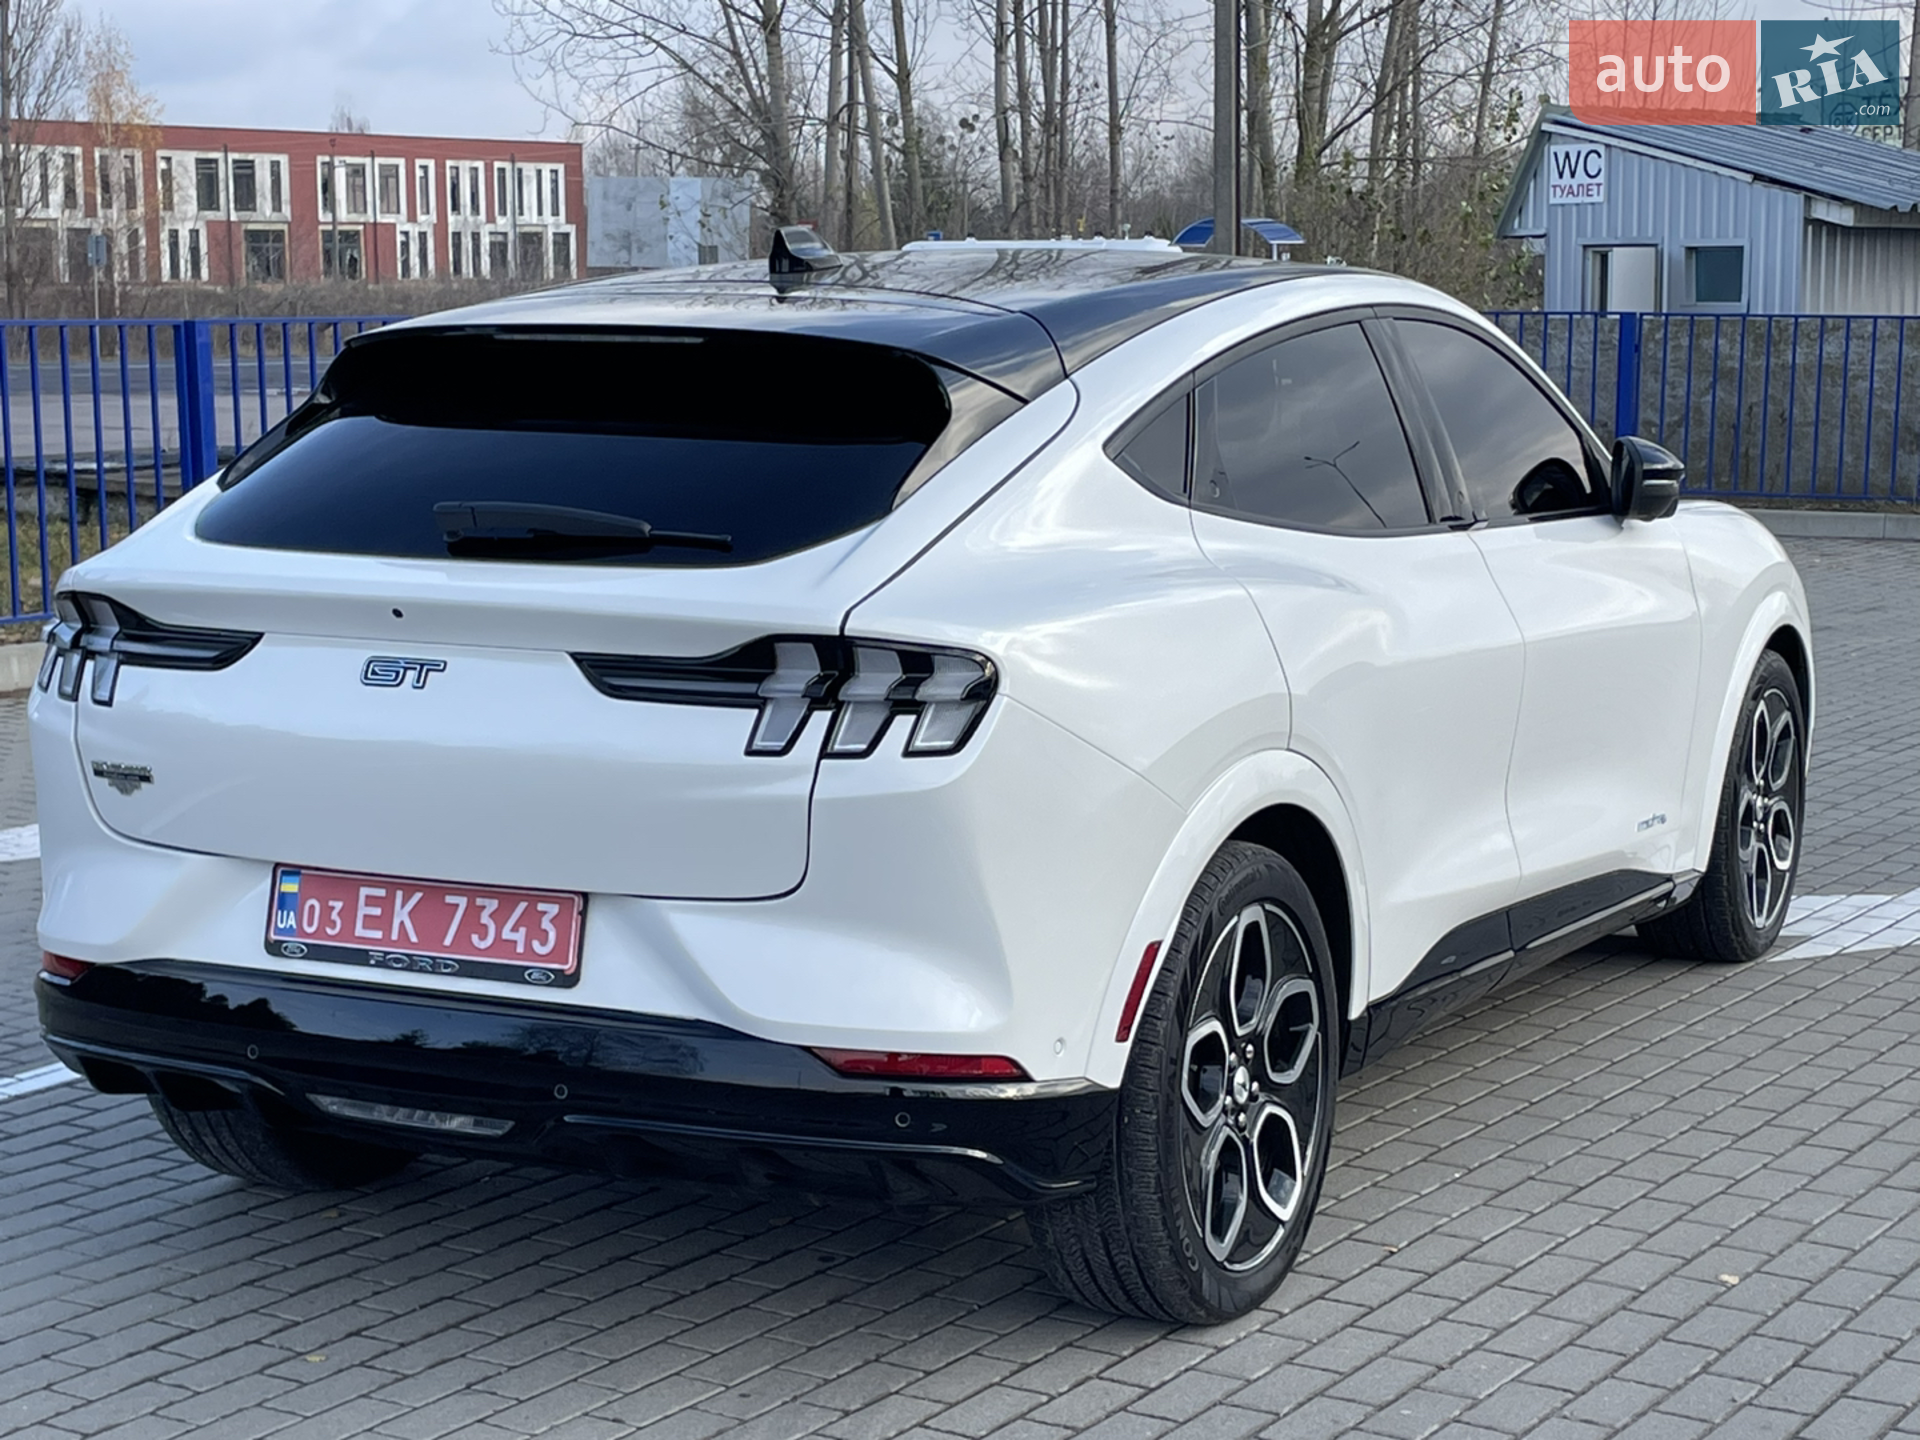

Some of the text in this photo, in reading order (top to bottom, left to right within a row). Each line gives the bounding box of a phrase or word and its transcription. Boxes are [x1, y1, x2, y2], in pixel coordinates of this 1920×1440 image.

[1553, 149, 1602, 180] WC
[1551, 183, 1603, 198] ТУАЛЕТ
[360, 655, 447, 690] GT
[276, 910, 297, 930] UA
[301, 886, 560, 956] 03 EK 7343
[368, 950, 460, 973] FORD
